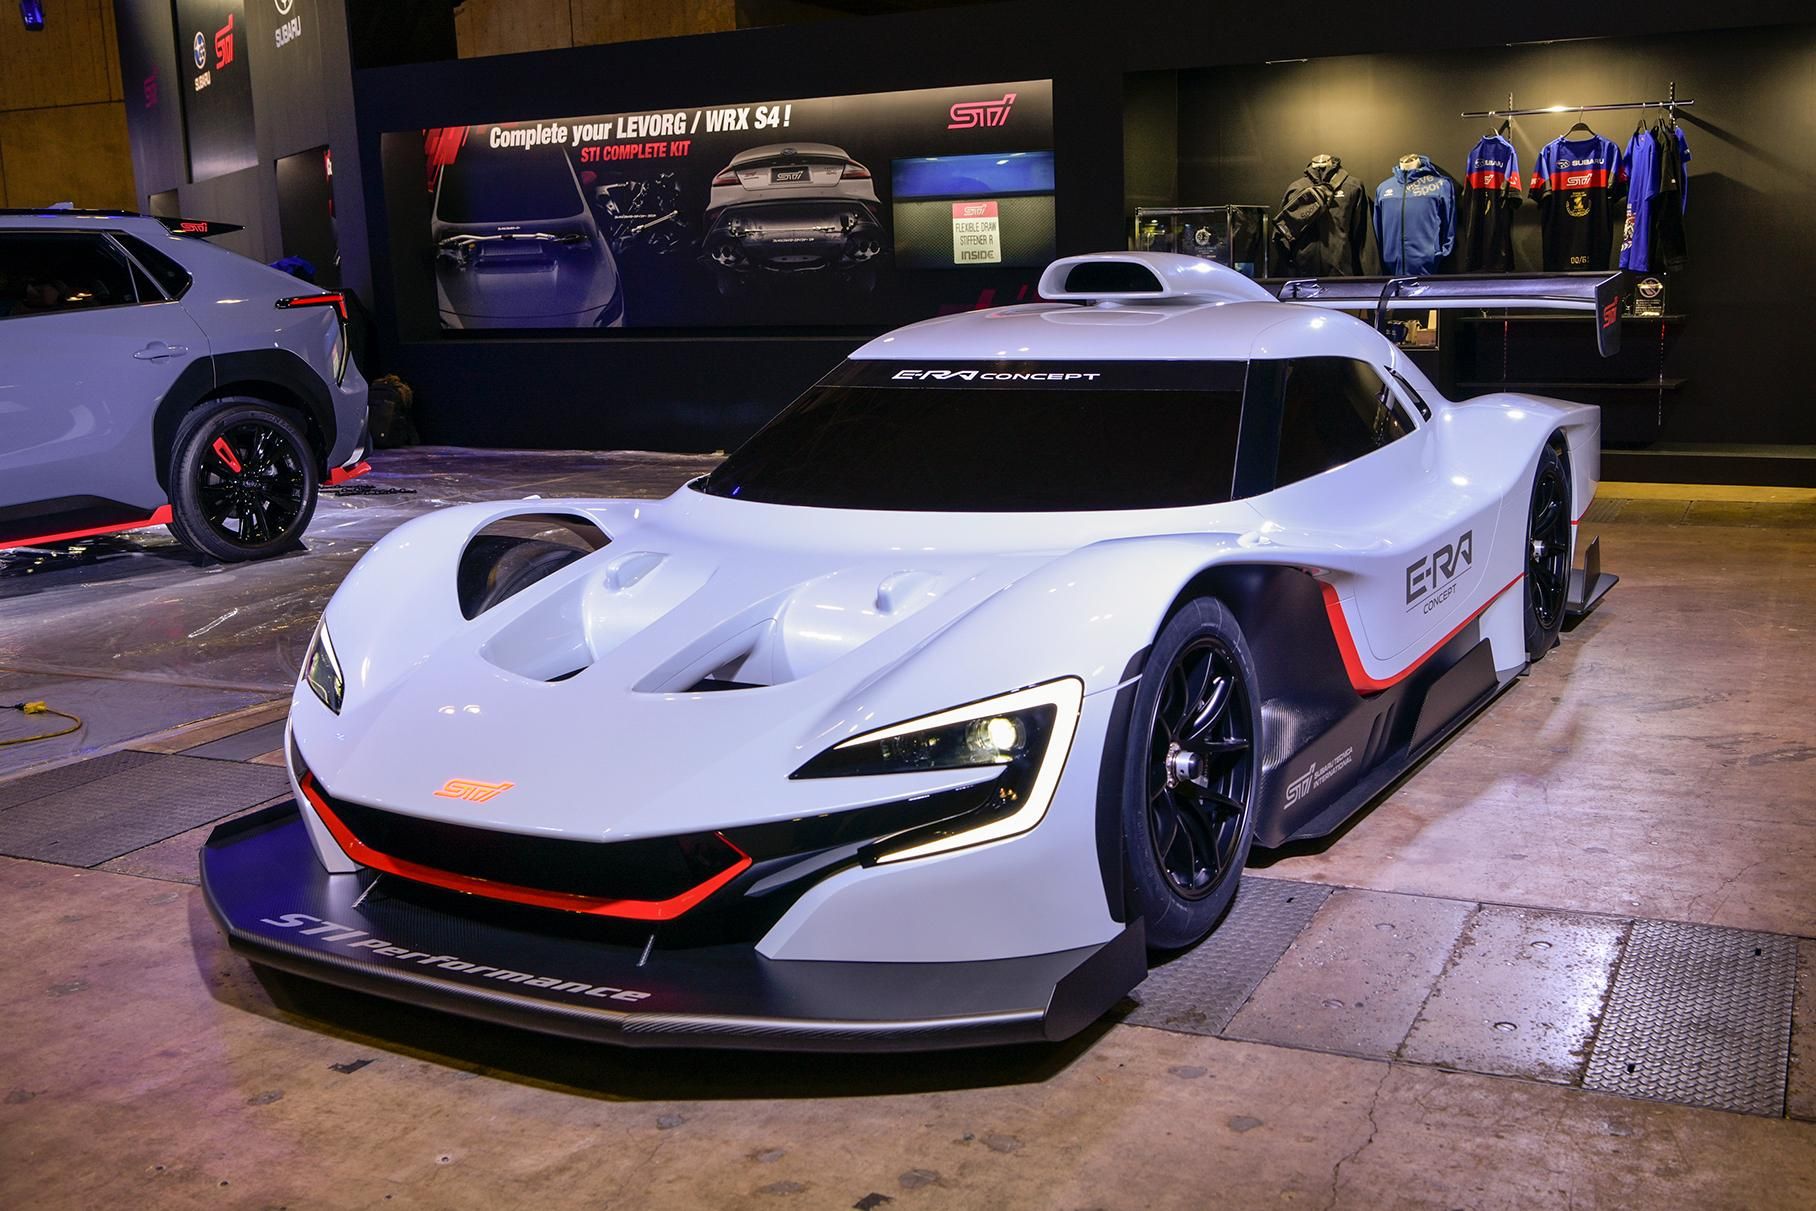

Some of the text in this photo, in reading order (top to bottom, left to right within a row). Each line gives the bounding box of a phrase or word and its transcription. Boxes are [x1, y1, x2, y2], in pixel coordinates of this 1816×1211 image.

[275, 16, 301, 48] SUBARU
[194, 70, 211, 91] SUBARU
[489, 122, 567, 150] Complete
[572, 121, 612, 147] your
[616, 112, 687, 140] LEVORG
[690, 111, 702, 134] /
[706, 108, 751, 133] WRX
[580, 141, 691, 163] STI COMPLETE KIT
[1571, 158, 1605, 167] SUBARU
[955, 221, 997, 233] FLEXIBLE DRAW
[960, 234, 994, 246] STIFFENER R
[961, 249, 995, 260] INSIDE
[980, 372, 1101, 381] CONCEPT
[1406, 529, 1473, 605] E-RA
[1423, 583, 1457, 615] CONCEPT
[1313, 755, 1353, 789] INTERNATIONAL
[1314, 759, 1334, 780] SUBARU
